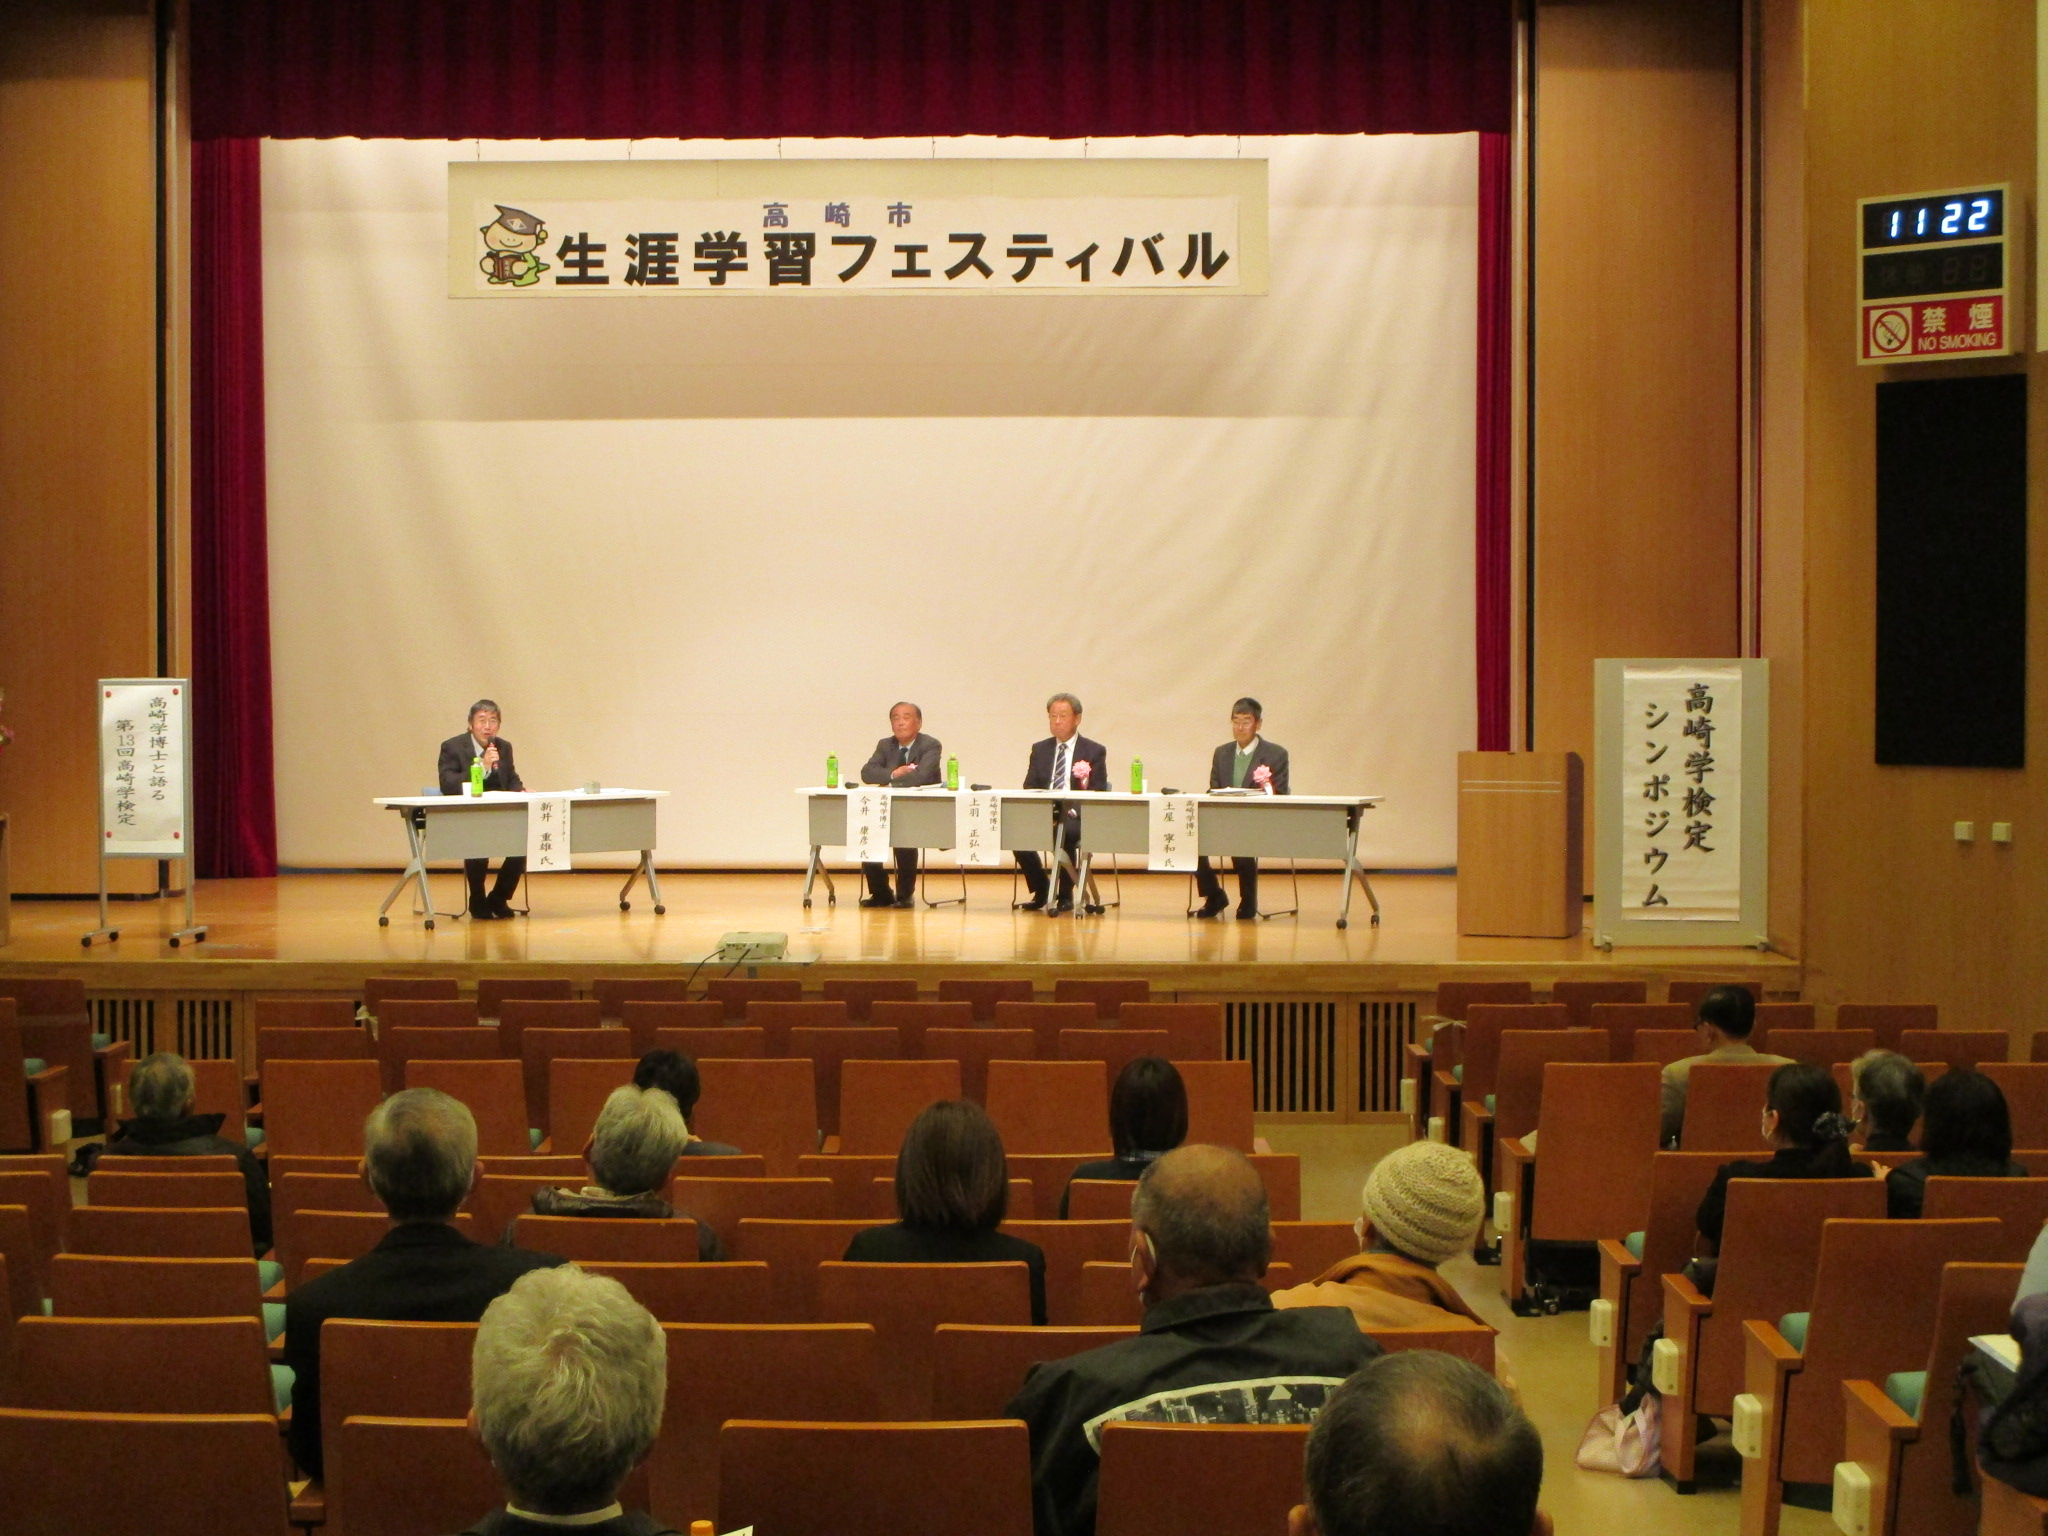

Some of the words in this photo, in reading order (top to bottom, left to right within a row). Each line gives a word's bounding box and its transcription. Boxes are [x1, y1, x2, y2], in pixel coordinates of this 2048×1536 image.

[762, 201, 913, 229] 高崎市
[555, 229, 1230, 287] 生涯学習フェスティバル
[1917, 337, 1936, 351] NO
[1939, 332, 1997, 350] SMOKING
[1922, 302, 1995, 334] 禁煙
[115, 719, 137, 826] 第13回高崎学検定
[148, 696, 169, 801] 高崎学博士と語る
[1682, 682, 1717, 853] 高崎学検定
[1642, 702, 1670, 907] シンポジウム
